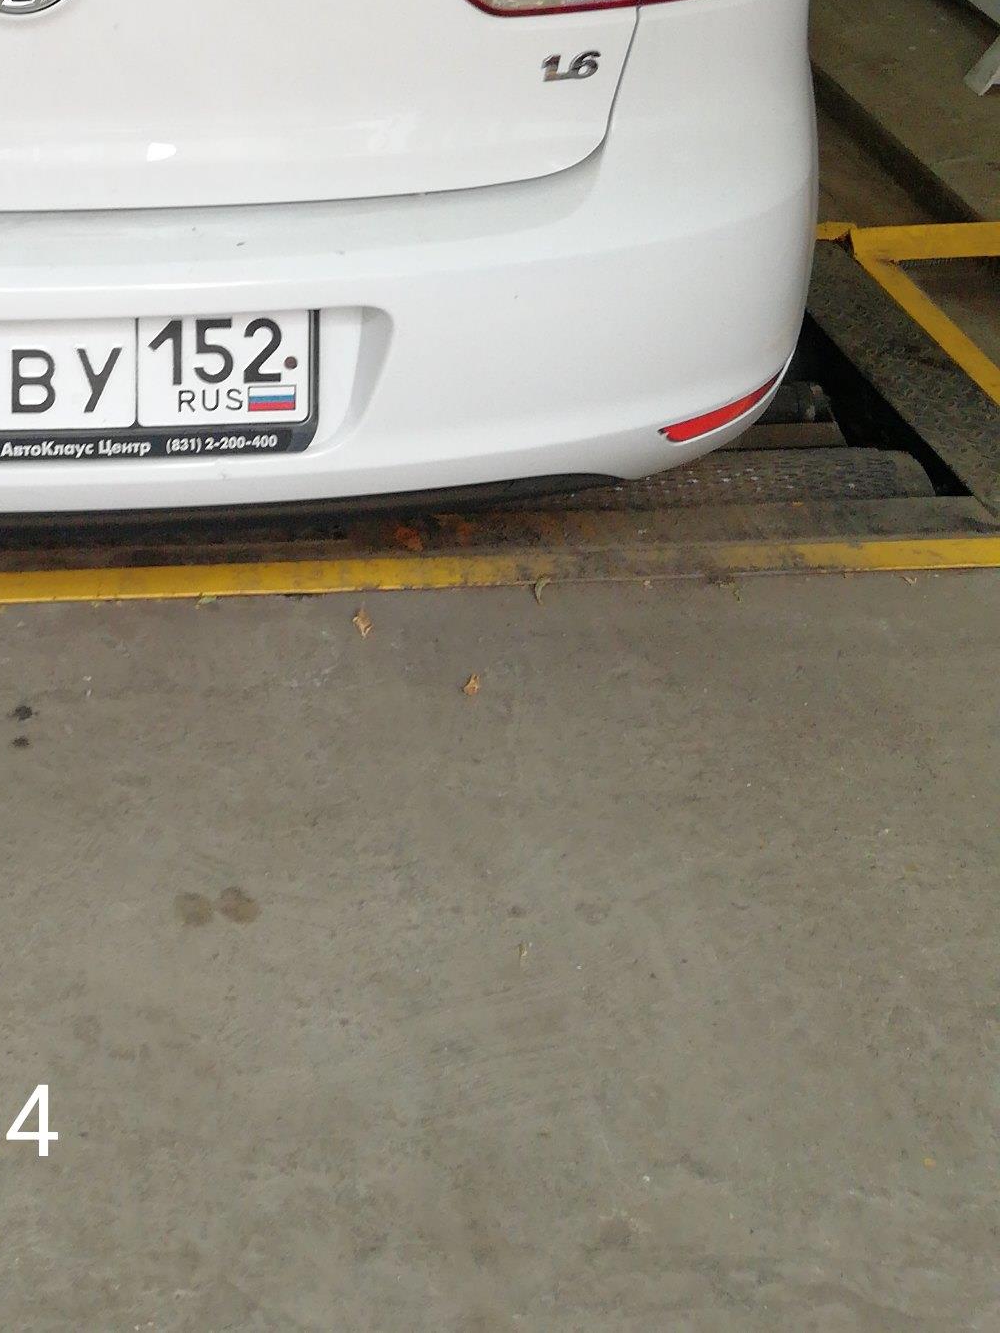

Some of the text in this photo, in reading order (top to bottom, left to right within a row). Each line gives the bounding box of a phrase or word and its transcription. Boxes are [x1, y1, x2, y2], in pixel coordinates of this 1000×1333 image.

[147, 318, 283, 386] 152
[177, 388, 243, 413] RUS
[0, 440, 94, 458] АвтоКлаус
[98, 437, 151, 456] Центр
[166, 438, 201, 454] (831)
[204, 434, 278, 451] 2-200-400
